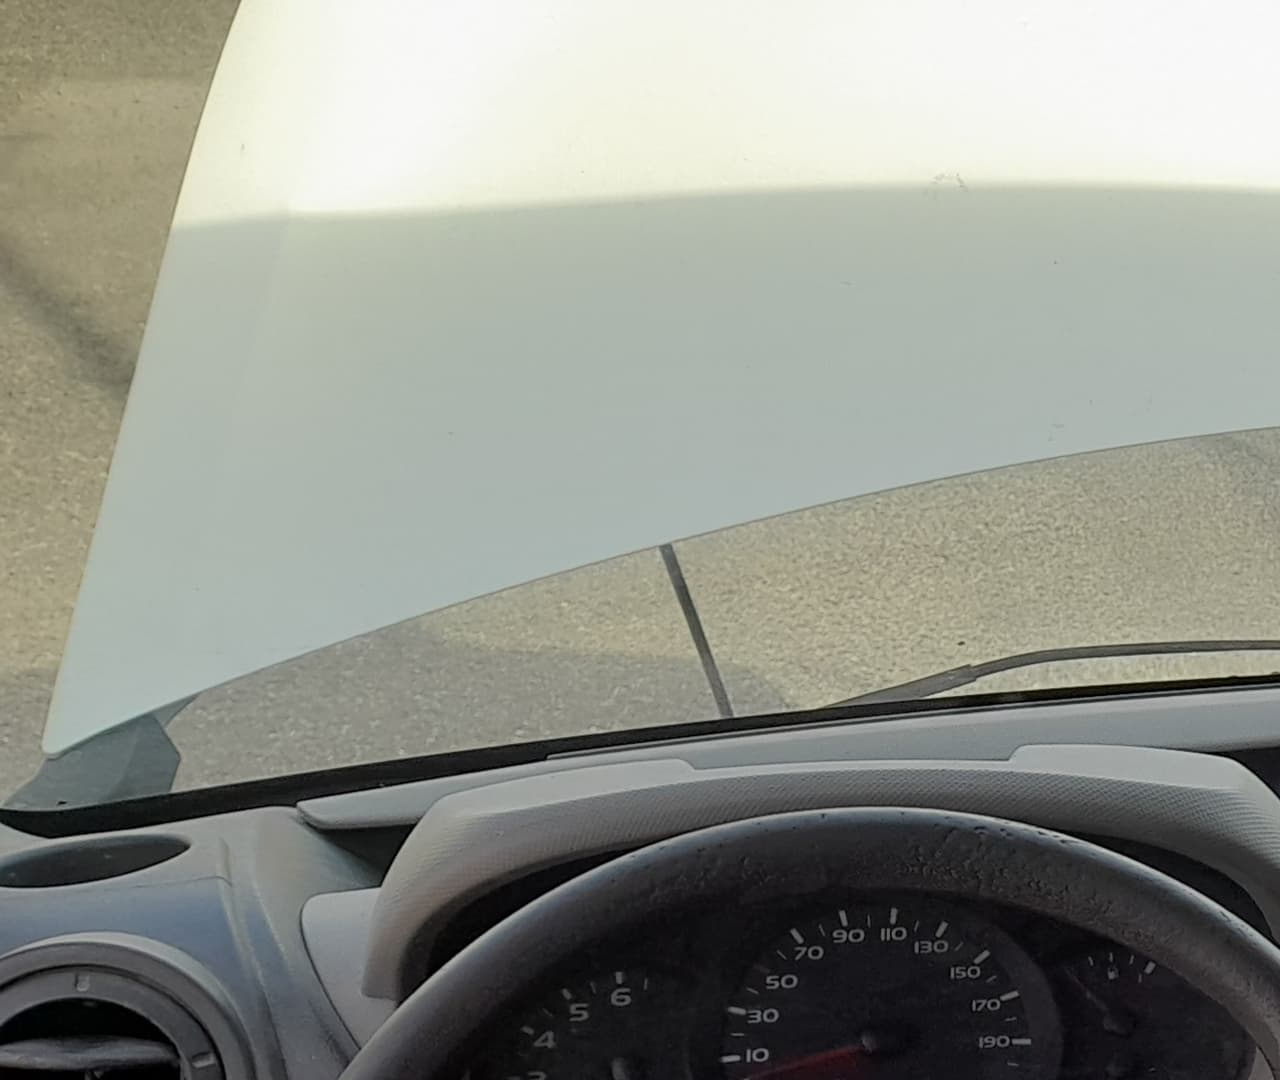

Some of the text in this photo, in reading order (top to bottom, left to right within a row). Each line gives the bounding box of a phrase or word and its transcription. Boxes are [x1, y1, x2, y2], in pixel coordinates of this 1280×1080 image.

[832, 929, 865, 943] 90
[881, 927, 907, 941] 110
[795, 946, 824, 960] 70
[914, 940, 949, 954] 130
[950, 966, 981, 979] 150
[765, 974, 799, 990] 50
[610, 988, 632, 1007] 6
[569, 1003, 590, 1022] 5
[972, 1000, 1001, 1012] 170
[747, 1008, 780, 1024] 30
[533, 1030, 556, 1049] 4
[979, 1036, 1010, 1049] 190
[746, 1048, 770, 1063] 10
